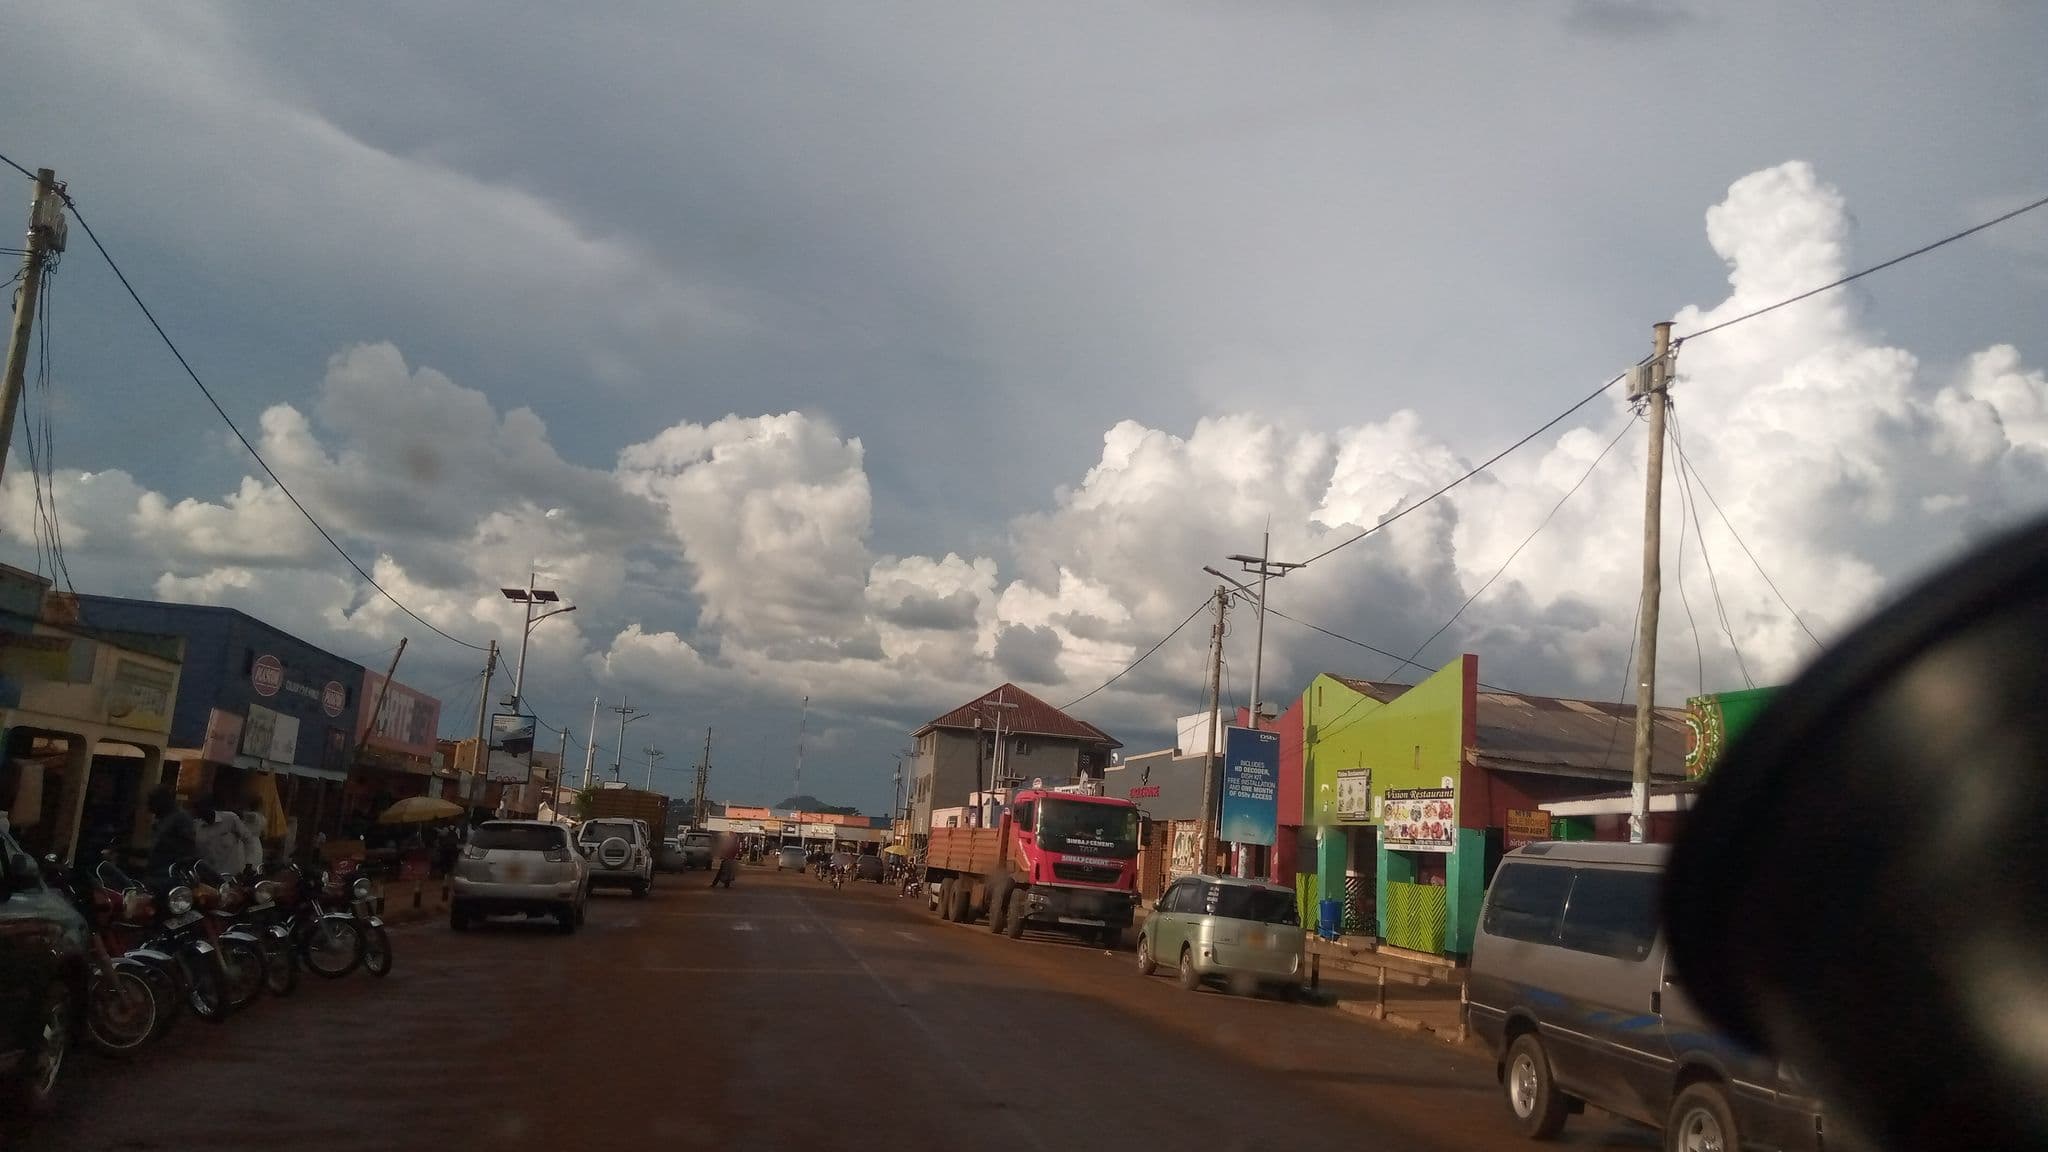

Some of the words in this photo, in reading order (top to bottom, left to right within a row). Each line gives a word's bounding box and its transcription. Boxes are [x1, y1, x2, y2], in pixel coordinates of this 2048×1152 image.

[1240, 760, 1265, 768] INCLUDES
[1241, 779, 1276, 789] INSTALLATION
[1253, 786, 1273, 794] MONTH
[1386, 789, 1408, 799] Vision
[1409, 788, 1453, 800] Restaurant
[1251, 793, 1273, 801] ACCESS
[1089, 840, 1113, 848] CEMENT
